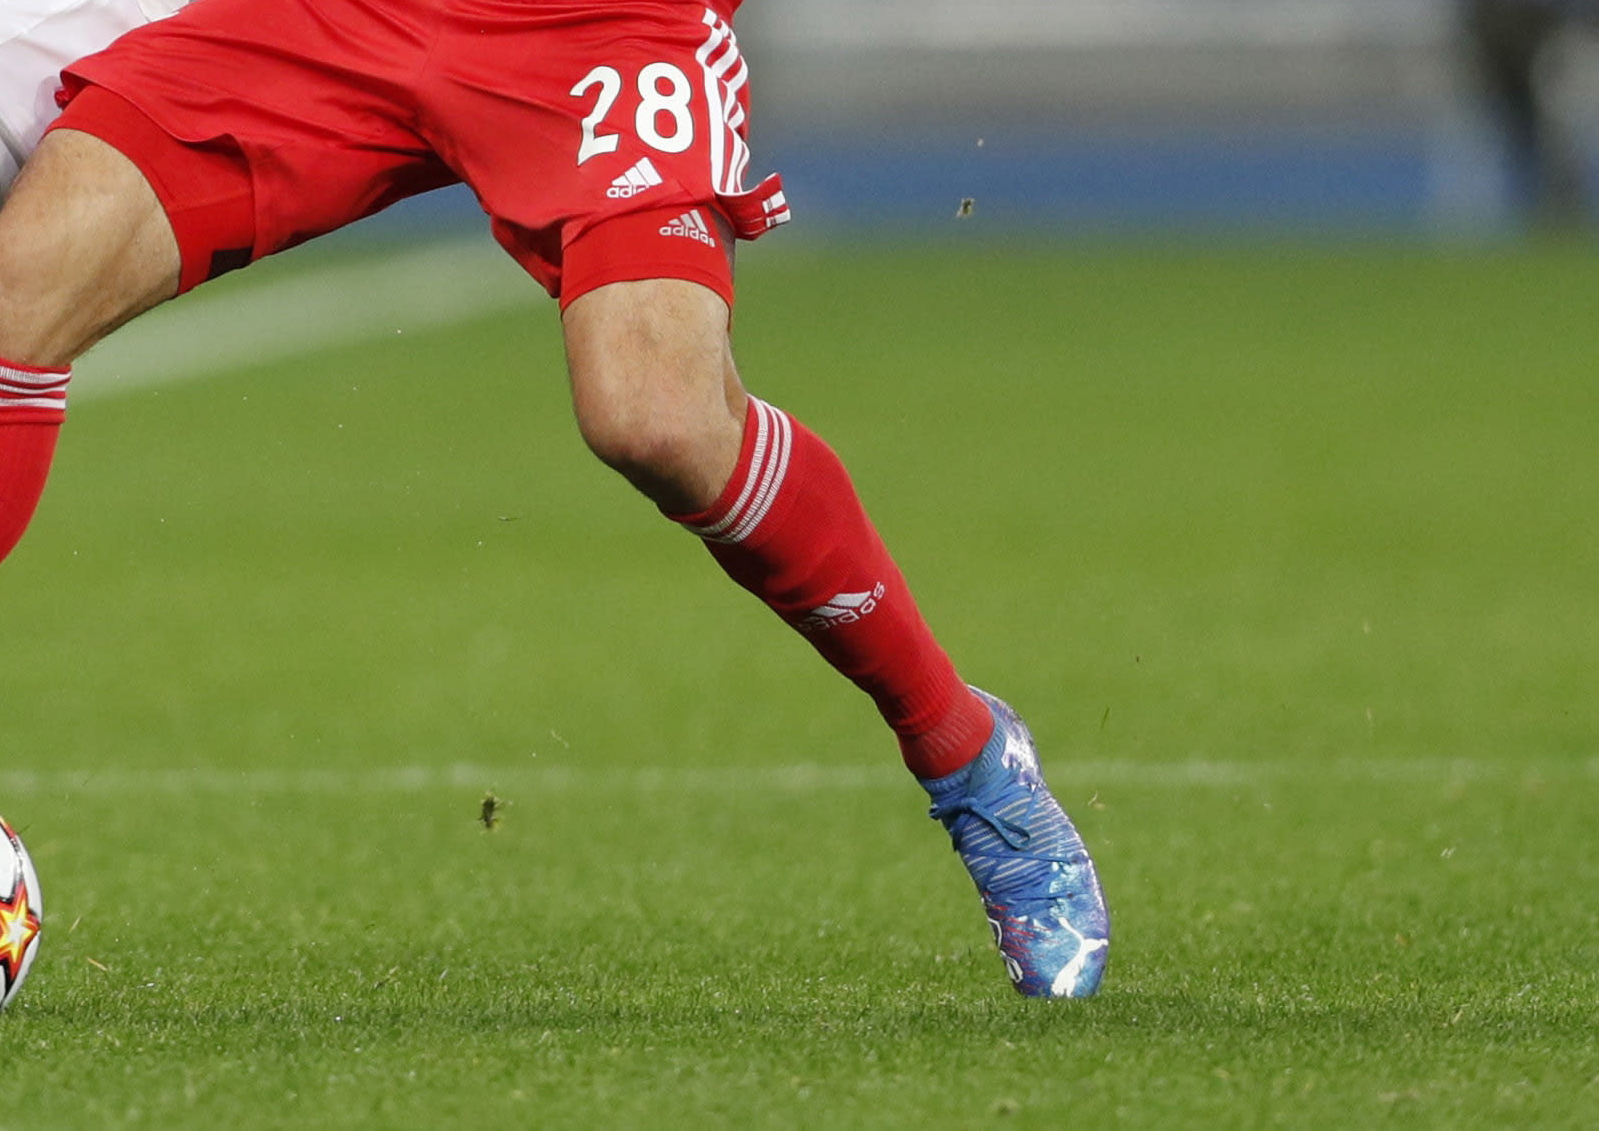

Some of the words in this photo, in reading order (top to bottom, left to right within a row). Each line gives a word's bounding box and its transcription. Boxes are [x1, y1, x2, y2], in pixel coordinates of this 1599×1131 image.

[569, 61, 694, 166] 28
[606, 183, 650, 199] adi
[659, 225, 716, 248] adidas
